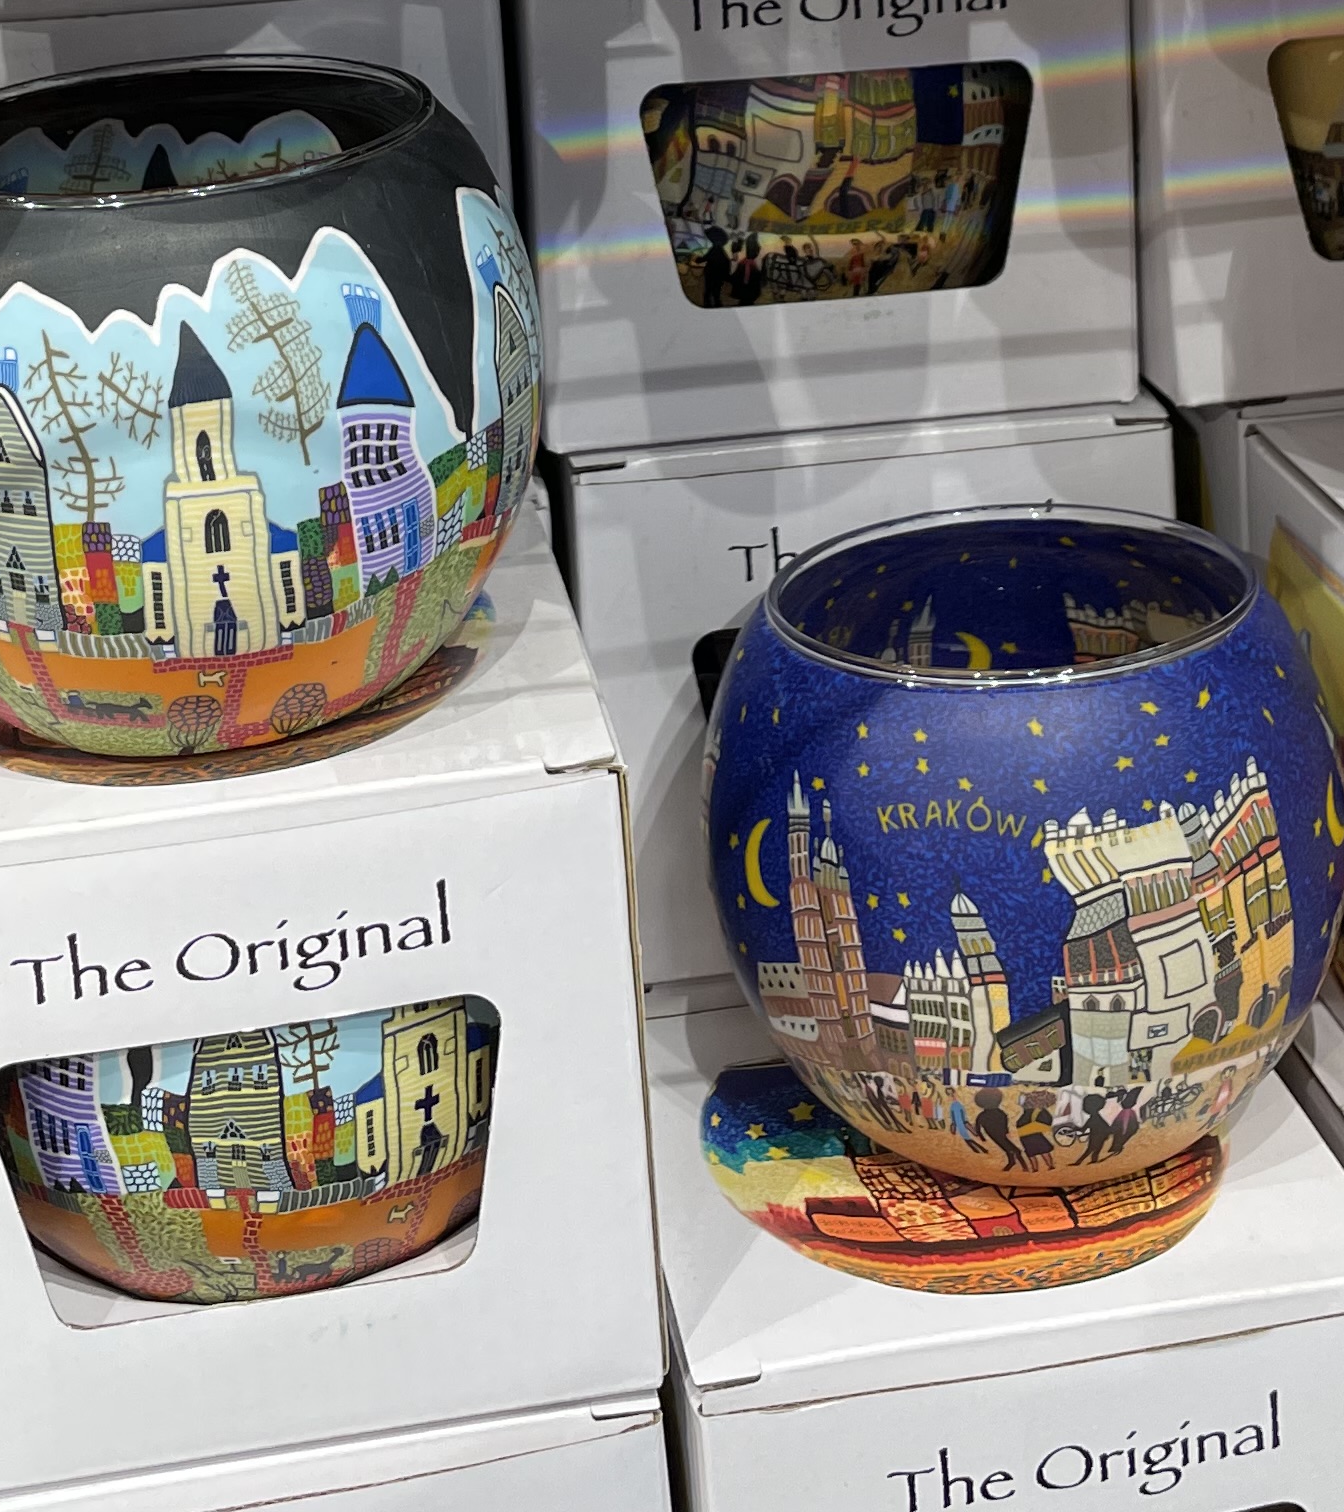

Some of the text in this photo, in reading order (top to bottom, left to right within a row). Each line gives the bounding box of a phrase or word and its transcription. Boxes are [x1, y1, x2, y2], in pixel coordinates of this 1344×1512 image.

[728, 526, 798, 582] Th
[877, 795, 1027, 838] KRAKÓW
[9, 878, 452, 1006] The Original
[887, 1389, 1281, 1512] The Original
